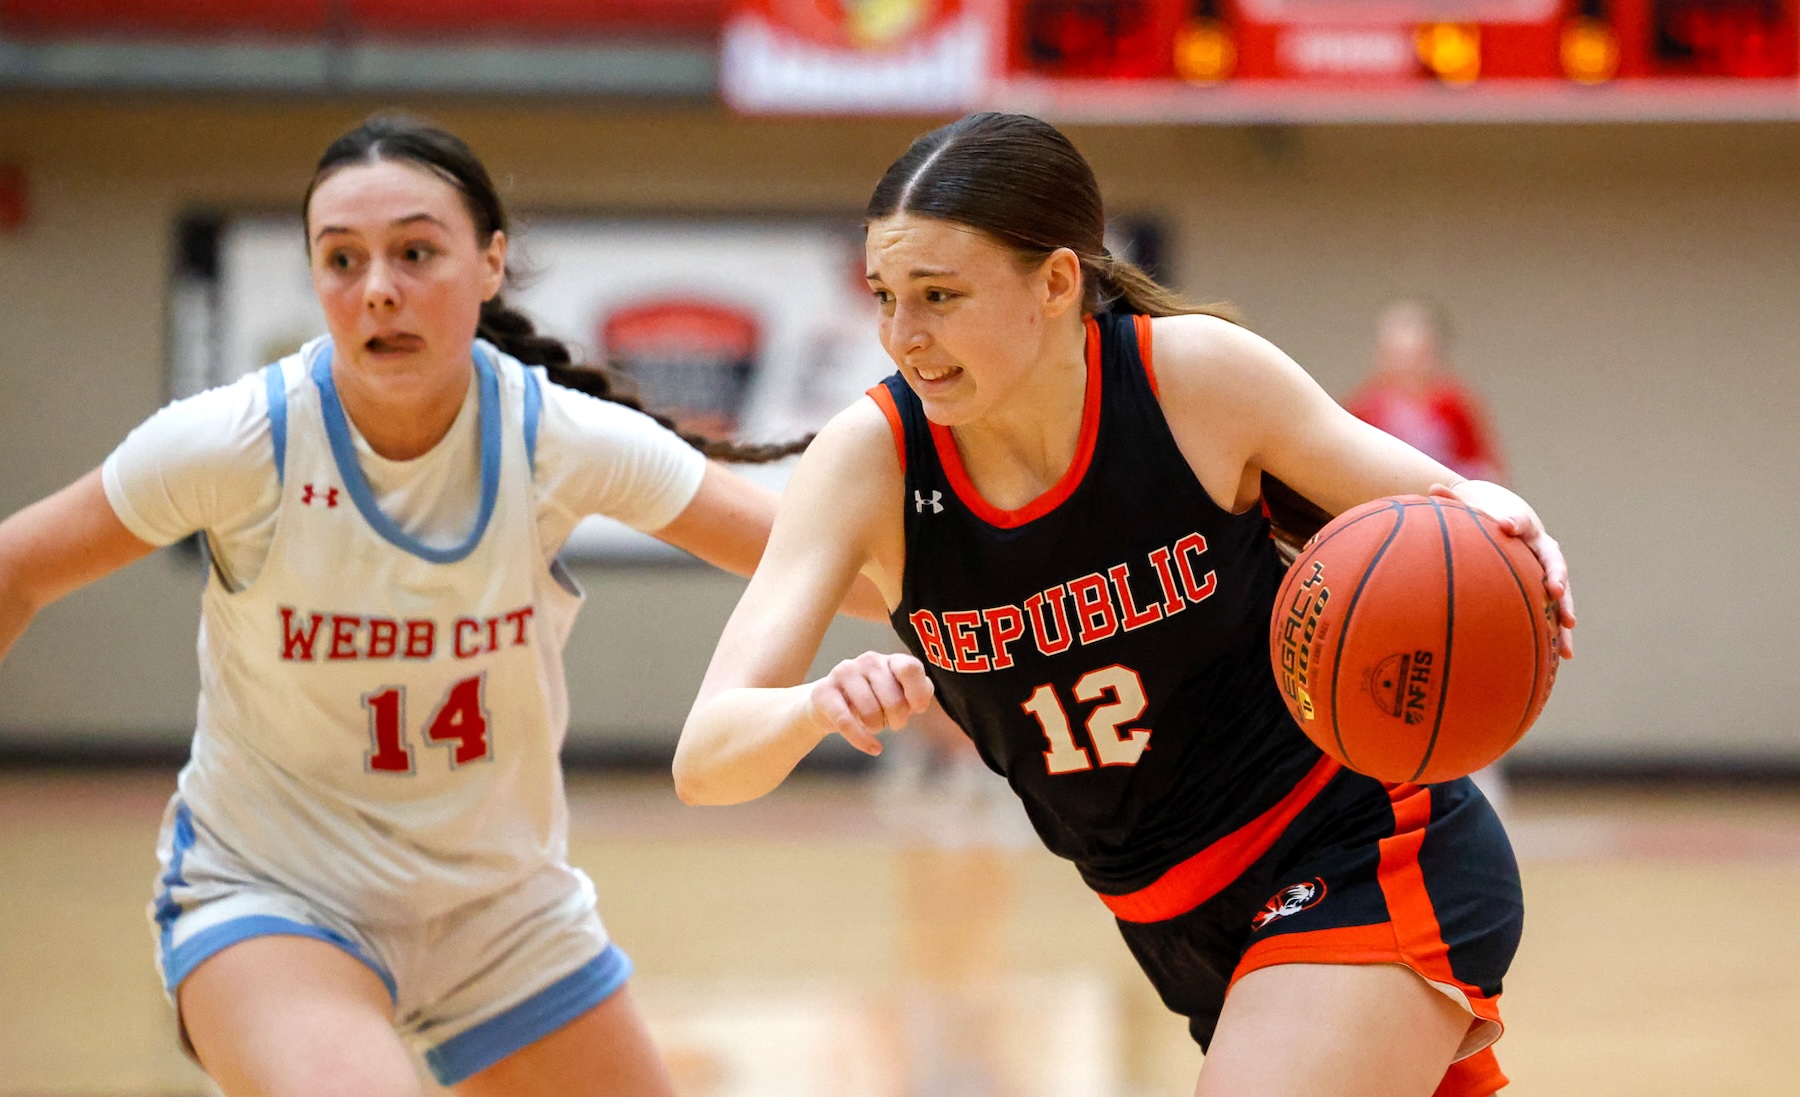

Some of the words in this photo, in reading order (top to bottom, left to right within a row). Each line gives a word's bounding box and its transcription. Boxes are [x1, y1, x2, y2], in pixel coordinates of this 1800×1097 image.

[277, 602, 437, 663] WEBB
[909, 532, 1217, 673] REPUBLIC
[1298, 587, 1331, 688] 1000
[360, 670, 495, 776] 14
[1020, 663, 1152, 775] 12
[1407, 649, 1433, 710] NFHS
